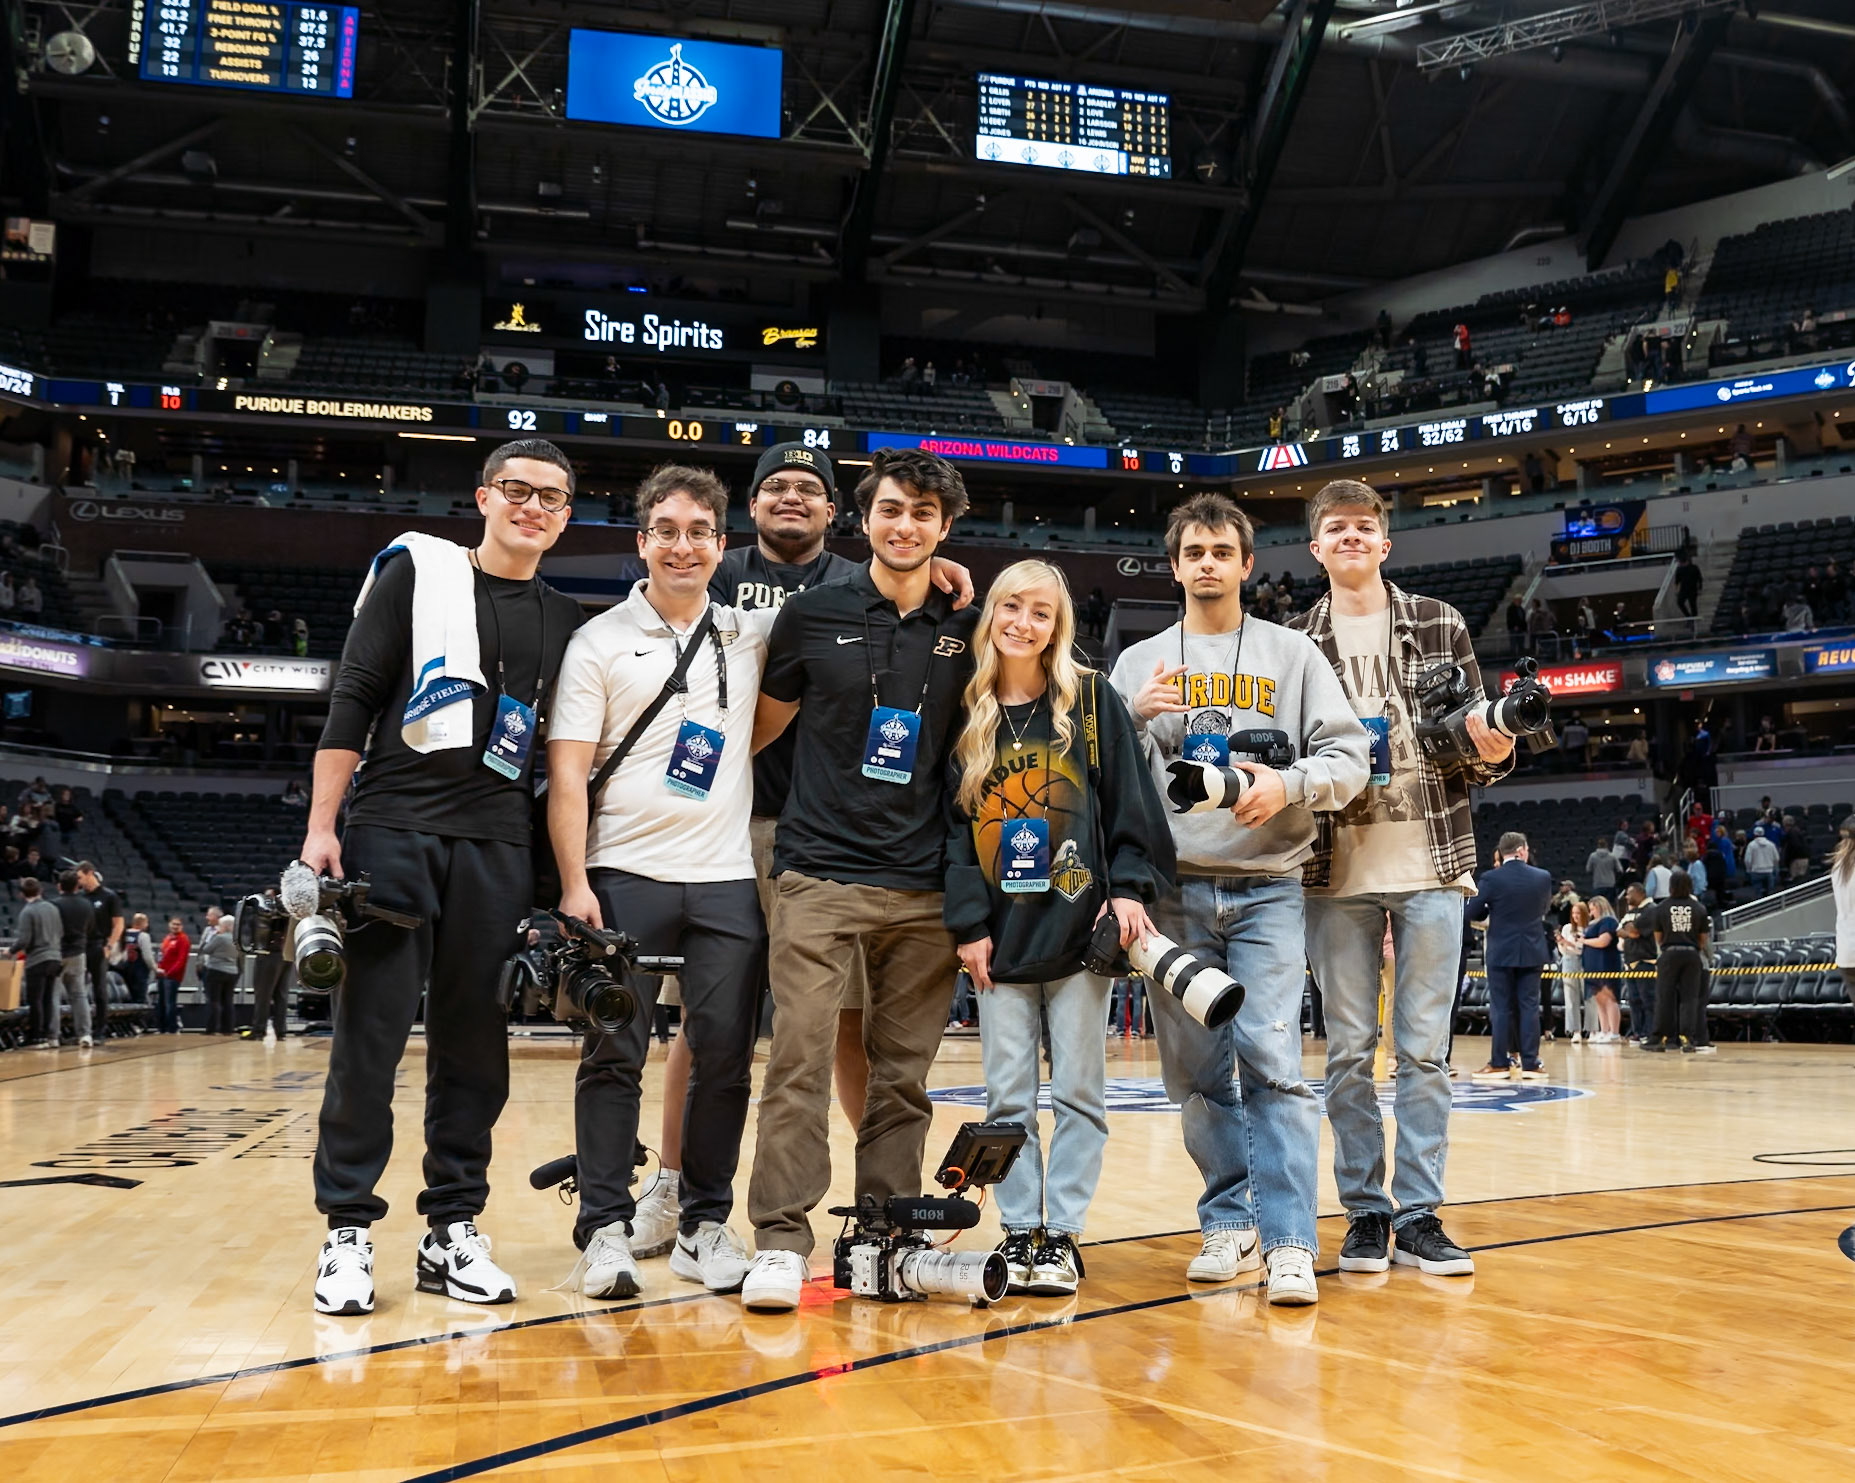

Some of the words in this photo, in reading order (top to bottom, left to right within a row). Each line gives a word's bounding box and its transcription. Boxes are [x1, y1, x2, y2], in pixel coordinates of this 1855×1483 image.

[211, 0, 241, 12] FIELD
[242, 2, 268, 14] GOAL
[159, 22, 188, 35] 41.7
[207, 12, 234, 26] FREE
[235, 14, 271, 30] THROW
[209, 28, 252, 42] 3-POINT
[163, 37, 181, 49] 32
[214, 42, 271, 57] REBOUNDS
[162, 50, 180, 63] 22
[219, 57, 263, 70] ASSISTS
[162, 64, 178, 77] 13
[209, 69, 271, 85] TURNOVERS
[301, 64, 319, 76] 24
[301, 77, 318, 90] 13
[584, 309, 635, 343] Sire
[643, 314, 723, 351] Spirits
[110, 391, 119, 406] 1
[161, 395, 182, 410] 10
[235, 396, 304, 415] PURDUE
[306, 400, 433, 422] BOILERMAKERS
[507, 409, 537, 431] 92
[1563, 408, 1598, 426] 6/16
[668, 420, 703, 441] 0.0
[1418, 423, 1441, 434] FIELD
[1490, 418, 1532, 437] 14/16
[741, 431, 752, 445] 2
[803, 428, 831, 450] 84
[1381, 437, 1399, 452] 24
[1422, 428, 1464, 446] 32/62
[918, 439, 984, 459] ARIZONA
[986, 444, 1059, 462] WILDCATS
[1343, 443, 1360, 458] 26
[1122, 457, 1140, 471] 10
[1171, 460, 1182, 474] 0
[101, 506, 186, 521] LEXUS
[1582, 538, 1612, 554] BOOTH
[21, 644, 78, 667] DONUTS
[252, 664, 285, 674] CITY
[291, 664, 328, 676] WIDE
[1676, 660, 1715, 671] REPUBLIC
[1554, 677, 1562, 687] N
[1564, 670, 1616, 687] SHAKE
[429, 681, 471, 703] FIELDH
[866, 766, 908, 781] PHOTOGRAPHER
[666, 779, 706, 799] PHOTOGRAPHER
[1005, 880, 1046, 889] PHOTOGRAPHER
[1670, 905, 1692, 915] CSC
[1671, 914, 1692, 924] EVENT
[1672, 923, 1692, 932] STAFF
[912, 1208, 945, 1221] RØDE
